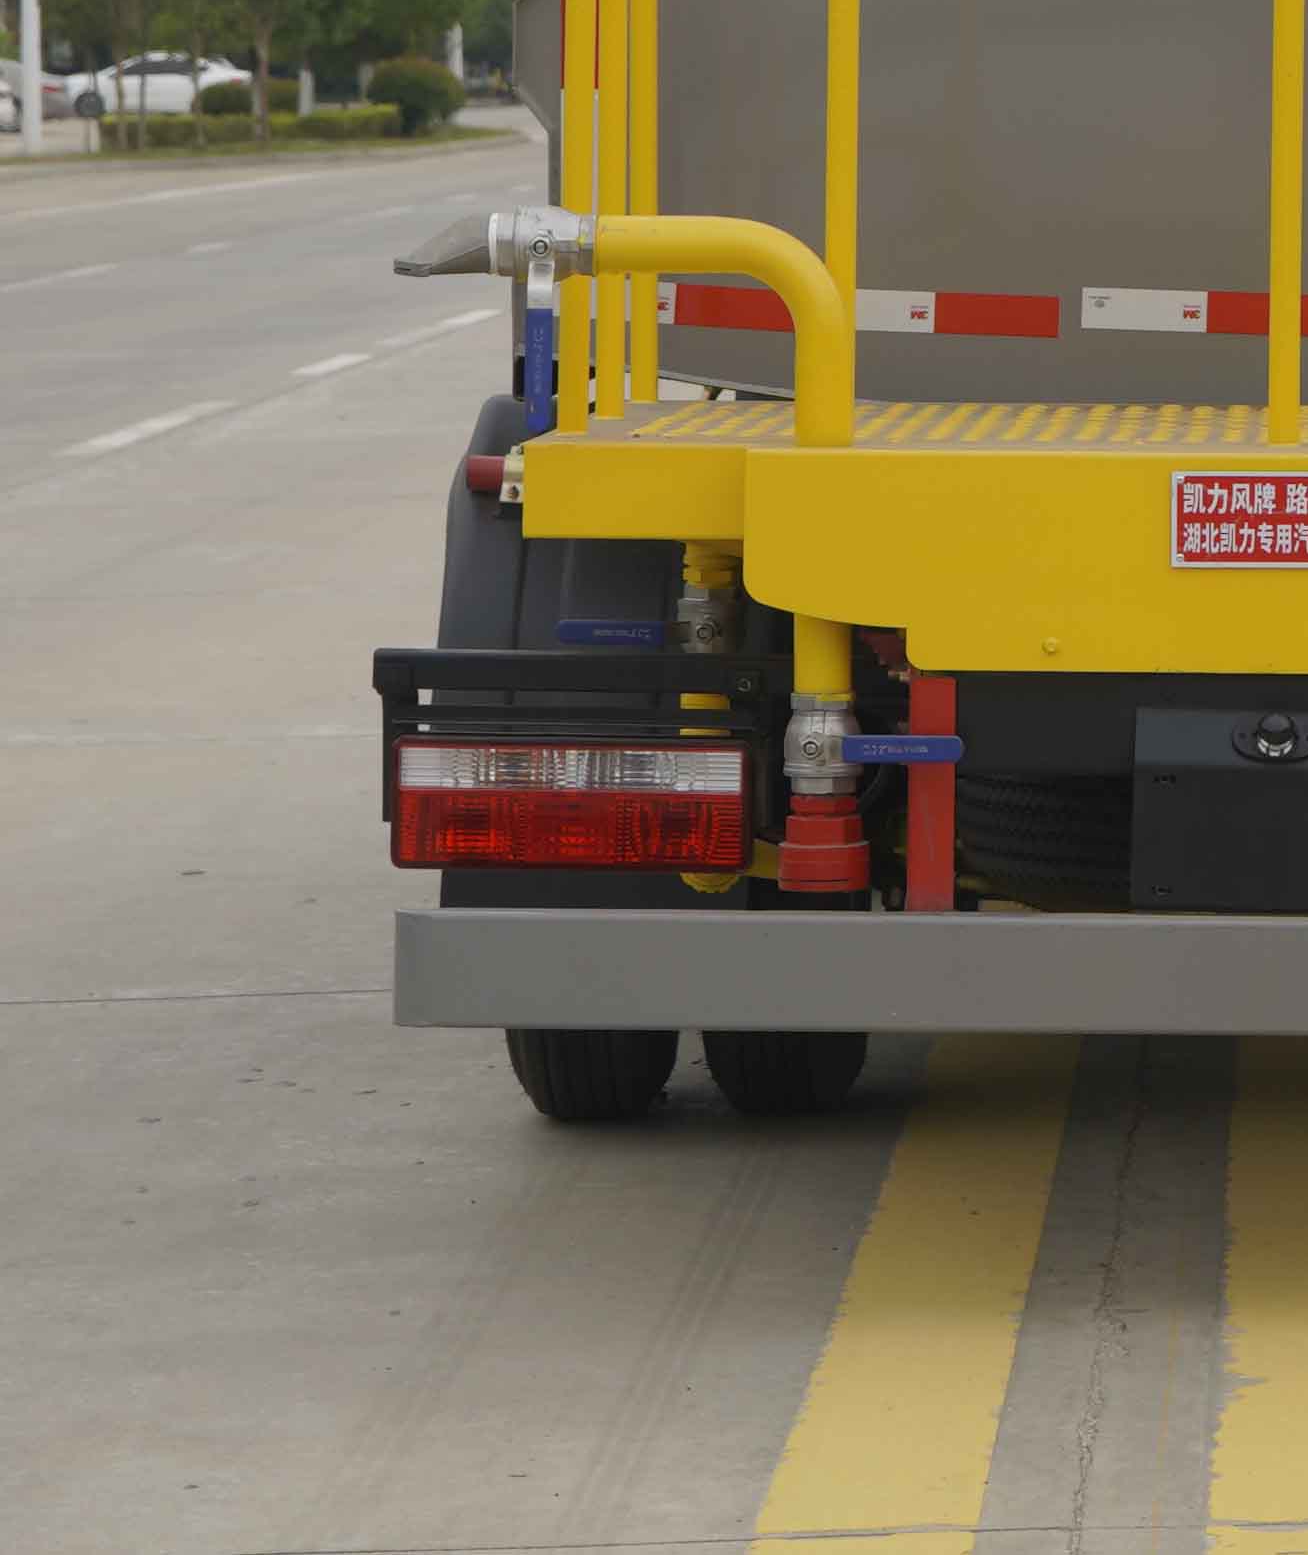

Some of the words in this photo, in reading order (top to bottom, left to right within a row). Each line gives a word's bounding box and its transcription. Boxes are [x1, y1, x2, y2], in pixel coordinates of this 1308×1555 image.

[910, 310, 929, 320] 3M
[1184, 309, 1201, 320] 3M
[1183, 482, 1277, 515] 凯力风牌
